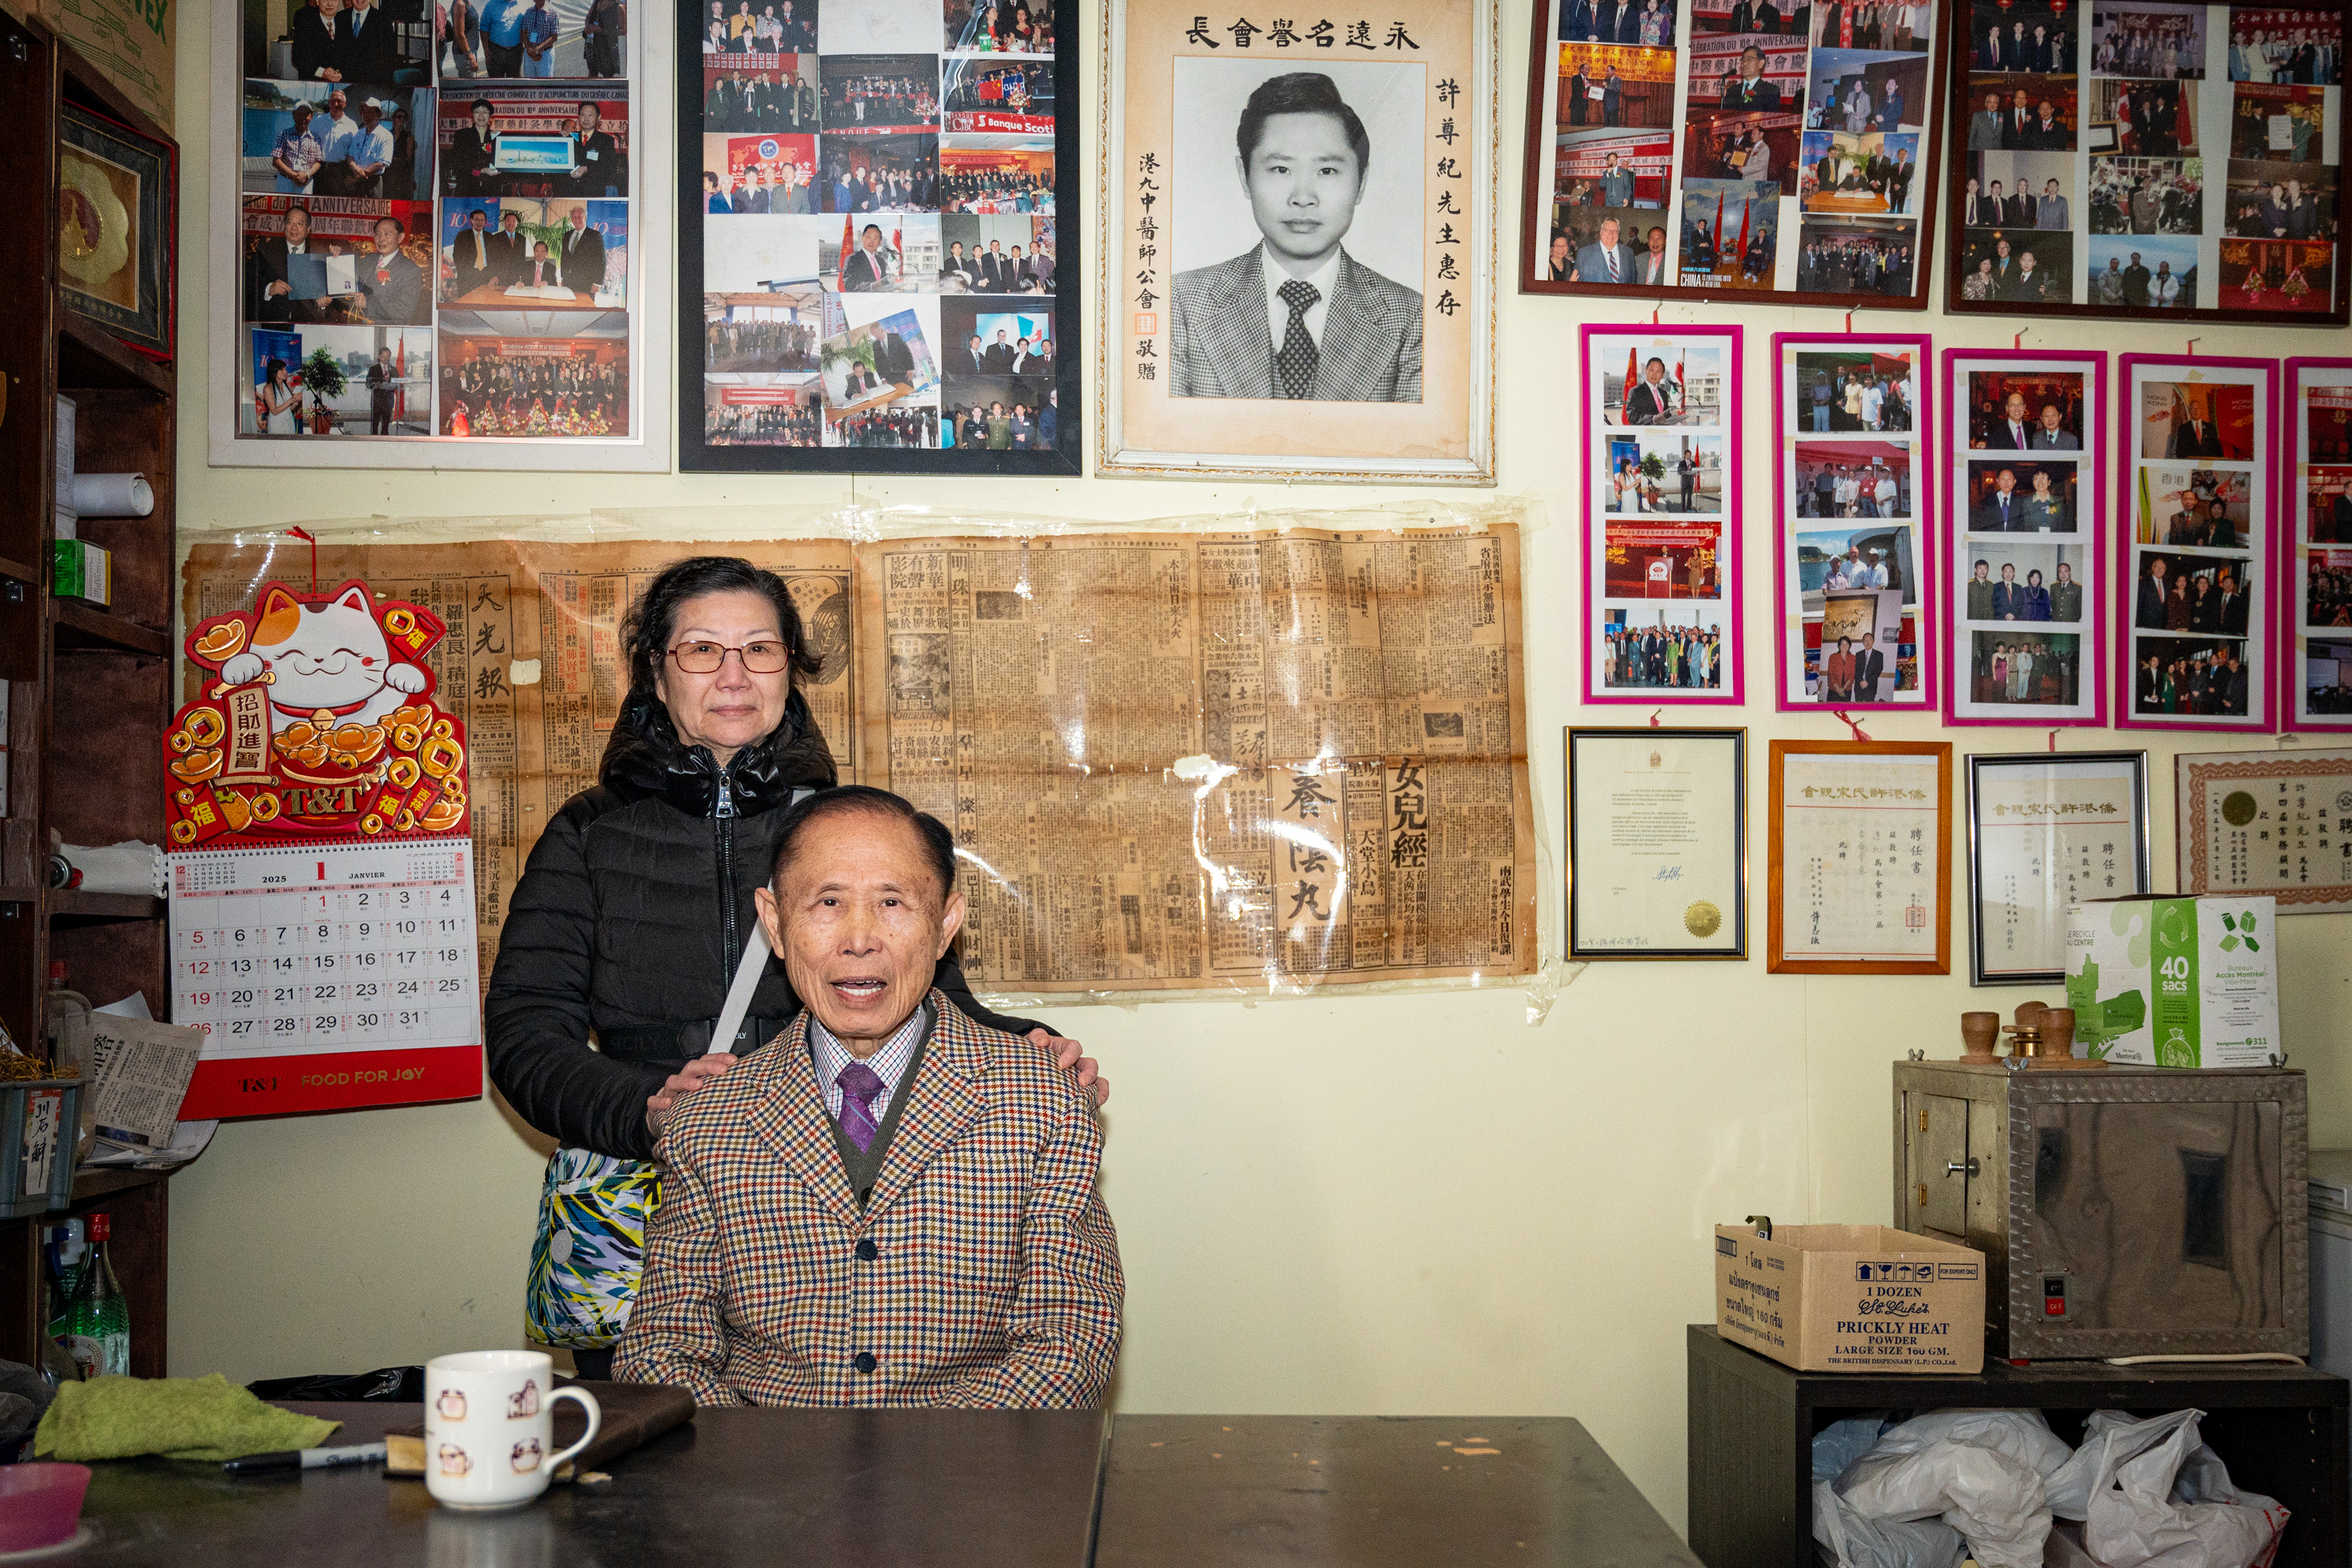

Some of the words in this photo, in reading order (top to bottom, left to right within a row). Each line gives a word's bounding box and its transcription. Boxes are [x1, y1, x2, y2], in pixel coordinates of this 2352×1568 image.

[1185, 17, 1420, 50] 永遠名譽會長
[1727, 40, 1736, 50] DU
[538, 105, 578, 115] ANNIVERSAIRE
[988, 118, 1023, 130] Banque
[1435, 78, 1461, 316] 許尊紀先生惠存
[311, 197, 391, 216] ANNIVERSAIRE
[1136, 153, 1161, 309] 港九中醫師公會
[1681, 274, 1701, 287] CHINA
[2162, 473, 2184, 486] 香港
[405, 628, 428, 650] 福
[235, 693, 262, 769] 招財進寶
[282, 786, 363, 815] T&T
[379, 794, 401, 816] 福
[409, 786, 431, 812] 吉祥
[190, 801, 216, 827] 福
[1388, 756, 1428, 869] 女兒經
[1838, 841, 1847, 860] 此聘
[1910, 828, 1923, 875] 聘任書
[1359, 829, 1376, 897] 天堂小鳥
[2102, 842, 2116, 888] 聘任書
[175, 865, 185, 874] 12
[315, 861, 328, 880] 1
[319, 895, 326, 907] 1
[358, 893, 369, 905] 2
[400, 891, 410, 903] 3
[440, 889, 451, 901] 4
[318, 925, 328, 937] 8
[360, 923, 370, 935] 9
[396, 921, 416, 933] 10
[439, 919, 455, 931] 11
[193, 931, 203, 943] 5
[235, 929, 245, 941] 6
[277, 927, 287, 939] 7
[2073, 930, 2095, 938] RECYCLE
[356, 953, 375, 965] 16
[397, 951, 417, 963] 17
[438, 949, 458, 961] 18
[189, 962, 209, 974] 12
[231, 959, 251, 972] 13
[273, 957, 293, 970] 14
[314, 956, 334, 968] 15
[2160, 956, 2188, 979] 40
[356, 983, 377, 996] 23
[398, 981, 419, 993] 24
[439, 979, 460, 992] 25
[2162, 981, 2187, 991] sacs
[232, 990, 253, 1003] 20
[275, 988, 293, 1000] 21
[315, 986, 336, 998] 22
[190, 993, 210, 1005] 19
[315, 1016, 337, 1028] 29
[357, 1014, 378, 1026] 30
[400, 1011, 419, 1023] 31
[232, 1020, 254, 1033] 27
[274, 1018, 295, 1031] 28
[2116, 1052, 2136, 1060] Montréal
[301, 1073, 350, 1087] FOOD
[355, 1070, 388, 1084] FOR
[393, 1068, 425, 1081] JOY
[1867, 1287, 1872, 1296] 1
[1877, 1287, 1922, 1297] DOZEN
[1885, 1300, 1929, 1317] Luke's
[1757, 1310, 1768, 1323] 160
[1837, 1321, 1905, 1334] PRICKLY
[1909, 1322, 1950, 1335] HEAT
[1868, 1336, 1917, 1345] POWDER
[1835, 1346, 1874, 1355] LARGE
[1877, 1346, 1903, 1355] SIZE
[1928, 1347, 1950, 1356] GM.
